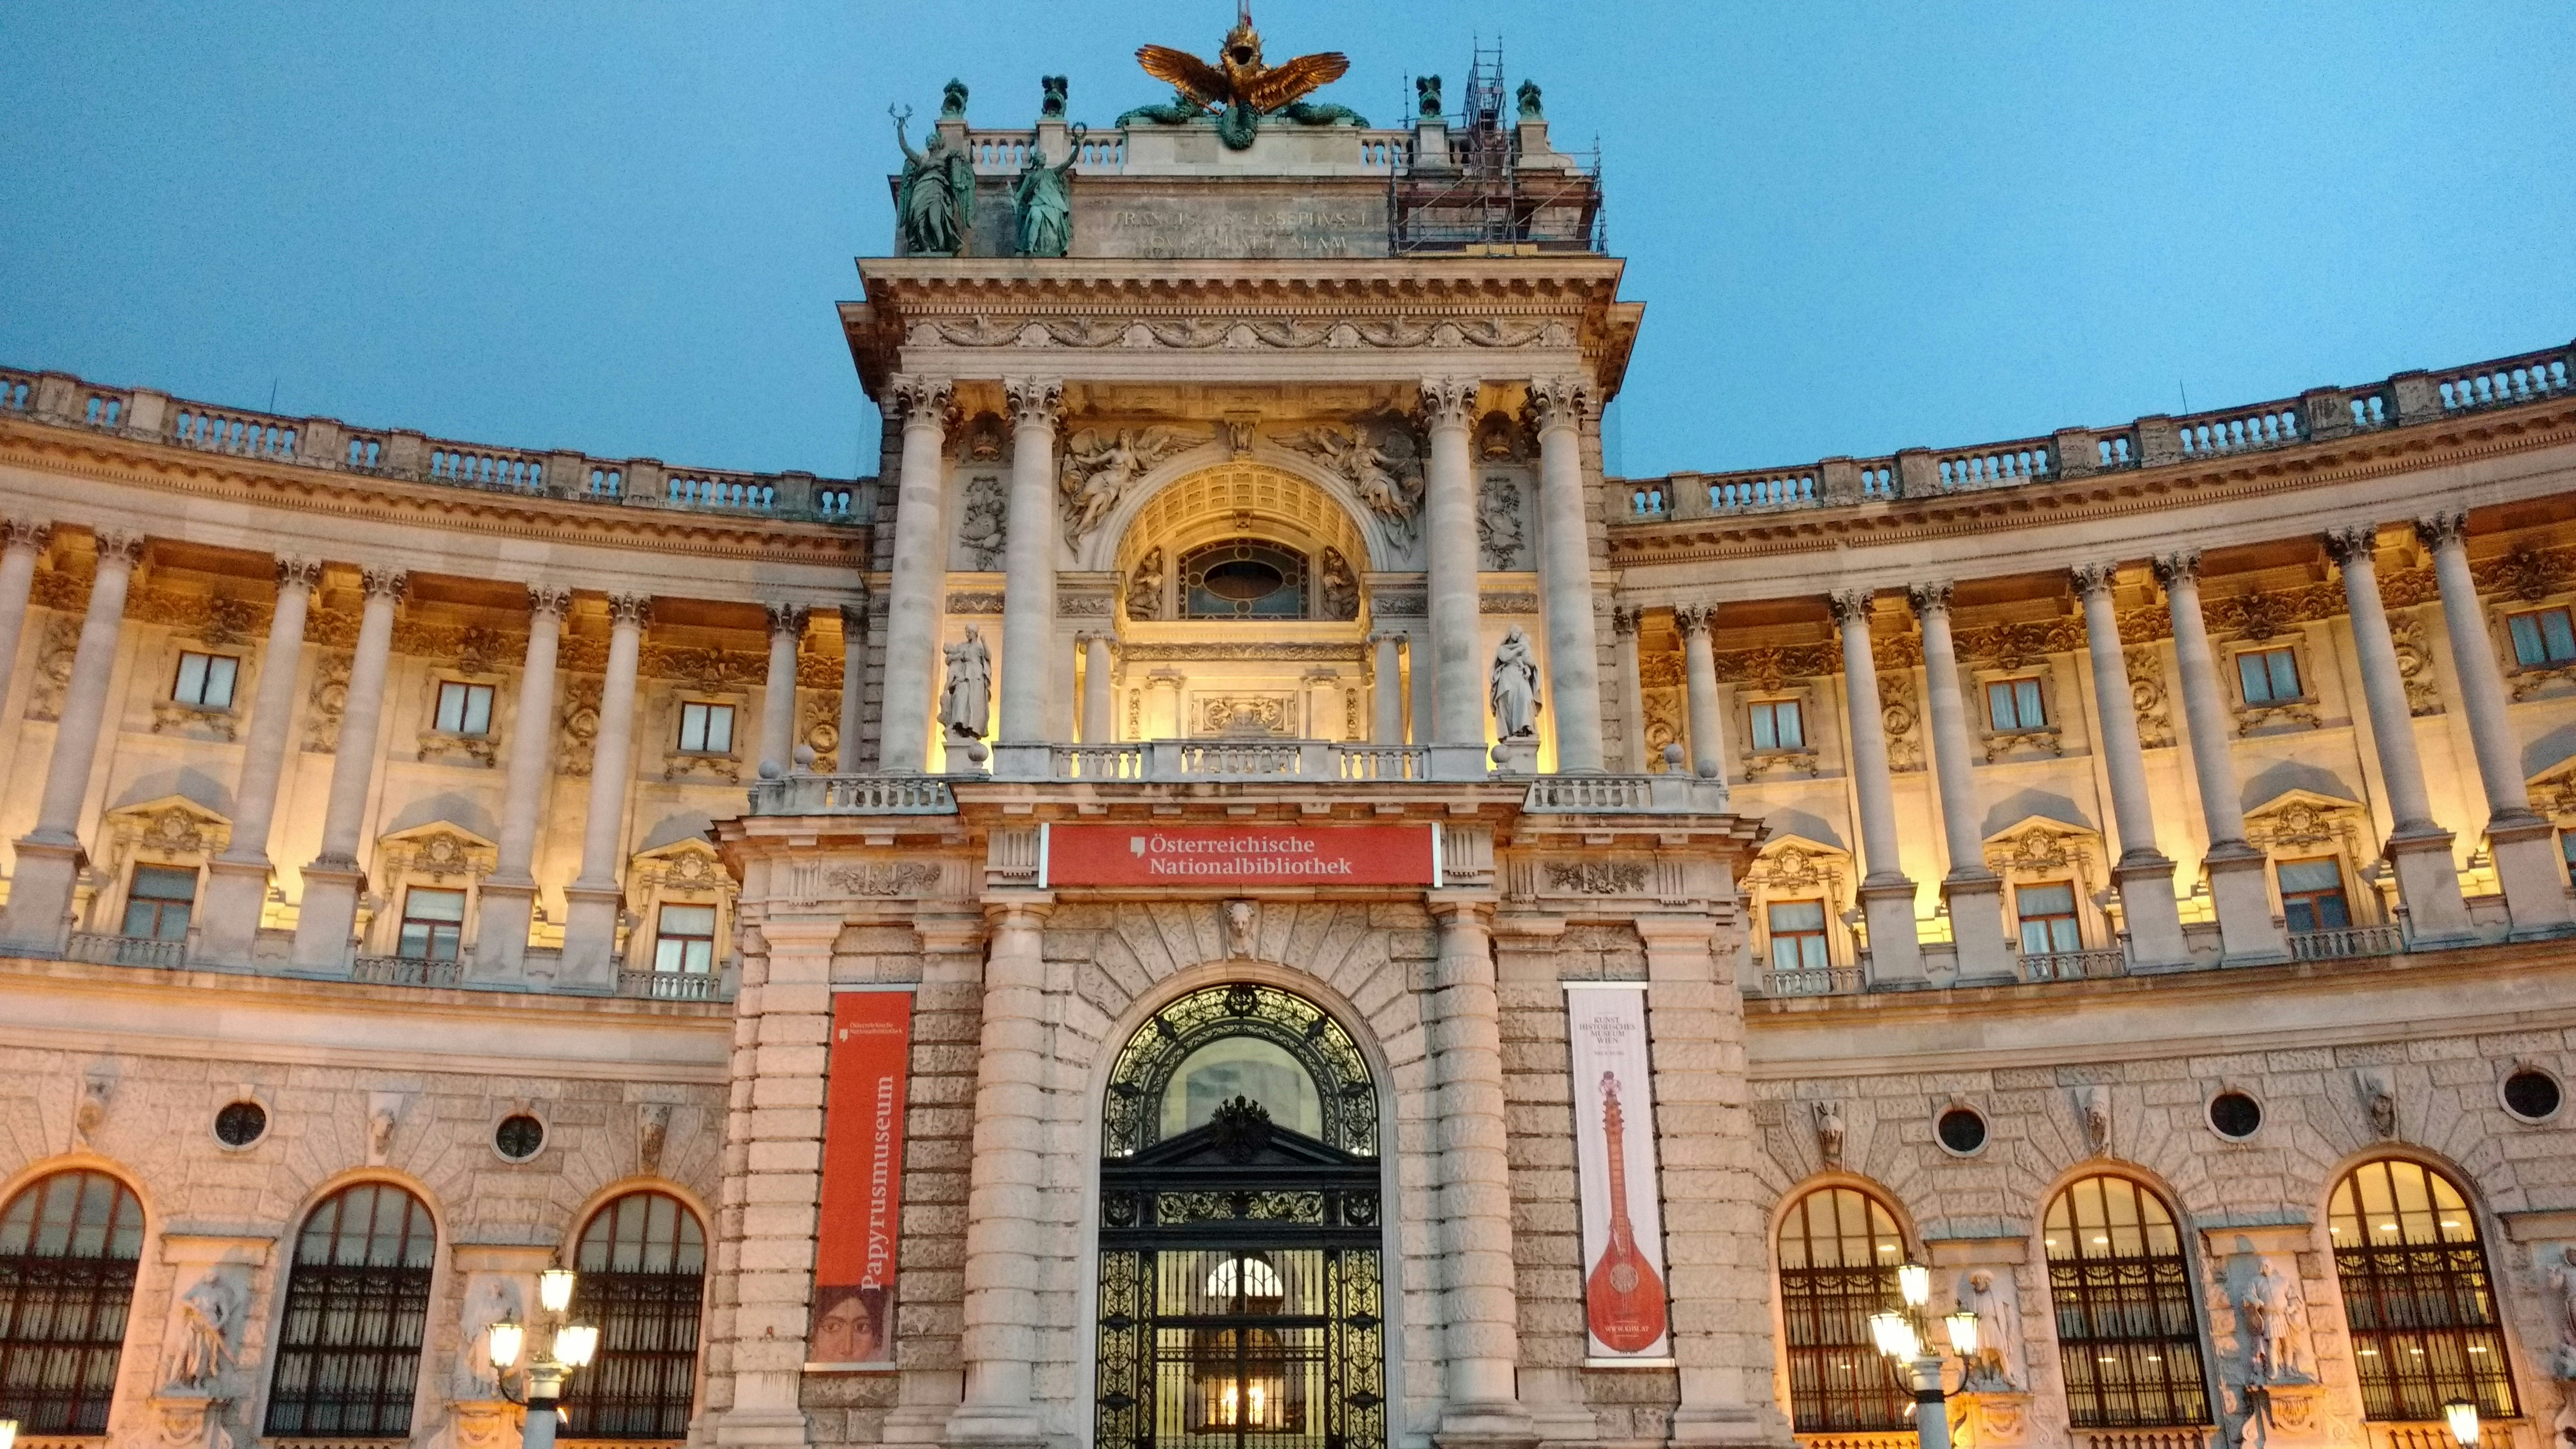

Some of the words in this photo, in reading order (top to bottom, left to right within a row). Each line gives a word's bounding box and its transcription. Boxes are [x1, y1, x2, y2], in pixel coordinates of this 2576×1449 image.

[1255, 212, 1347, 226] IOSEPHVS
[1150, 833, 1315, 853] Österreichische
[1150, 858, 1353, 875] Nationalbibliothek
[861, 1074, 894, 1291] Papyrusmuseum
